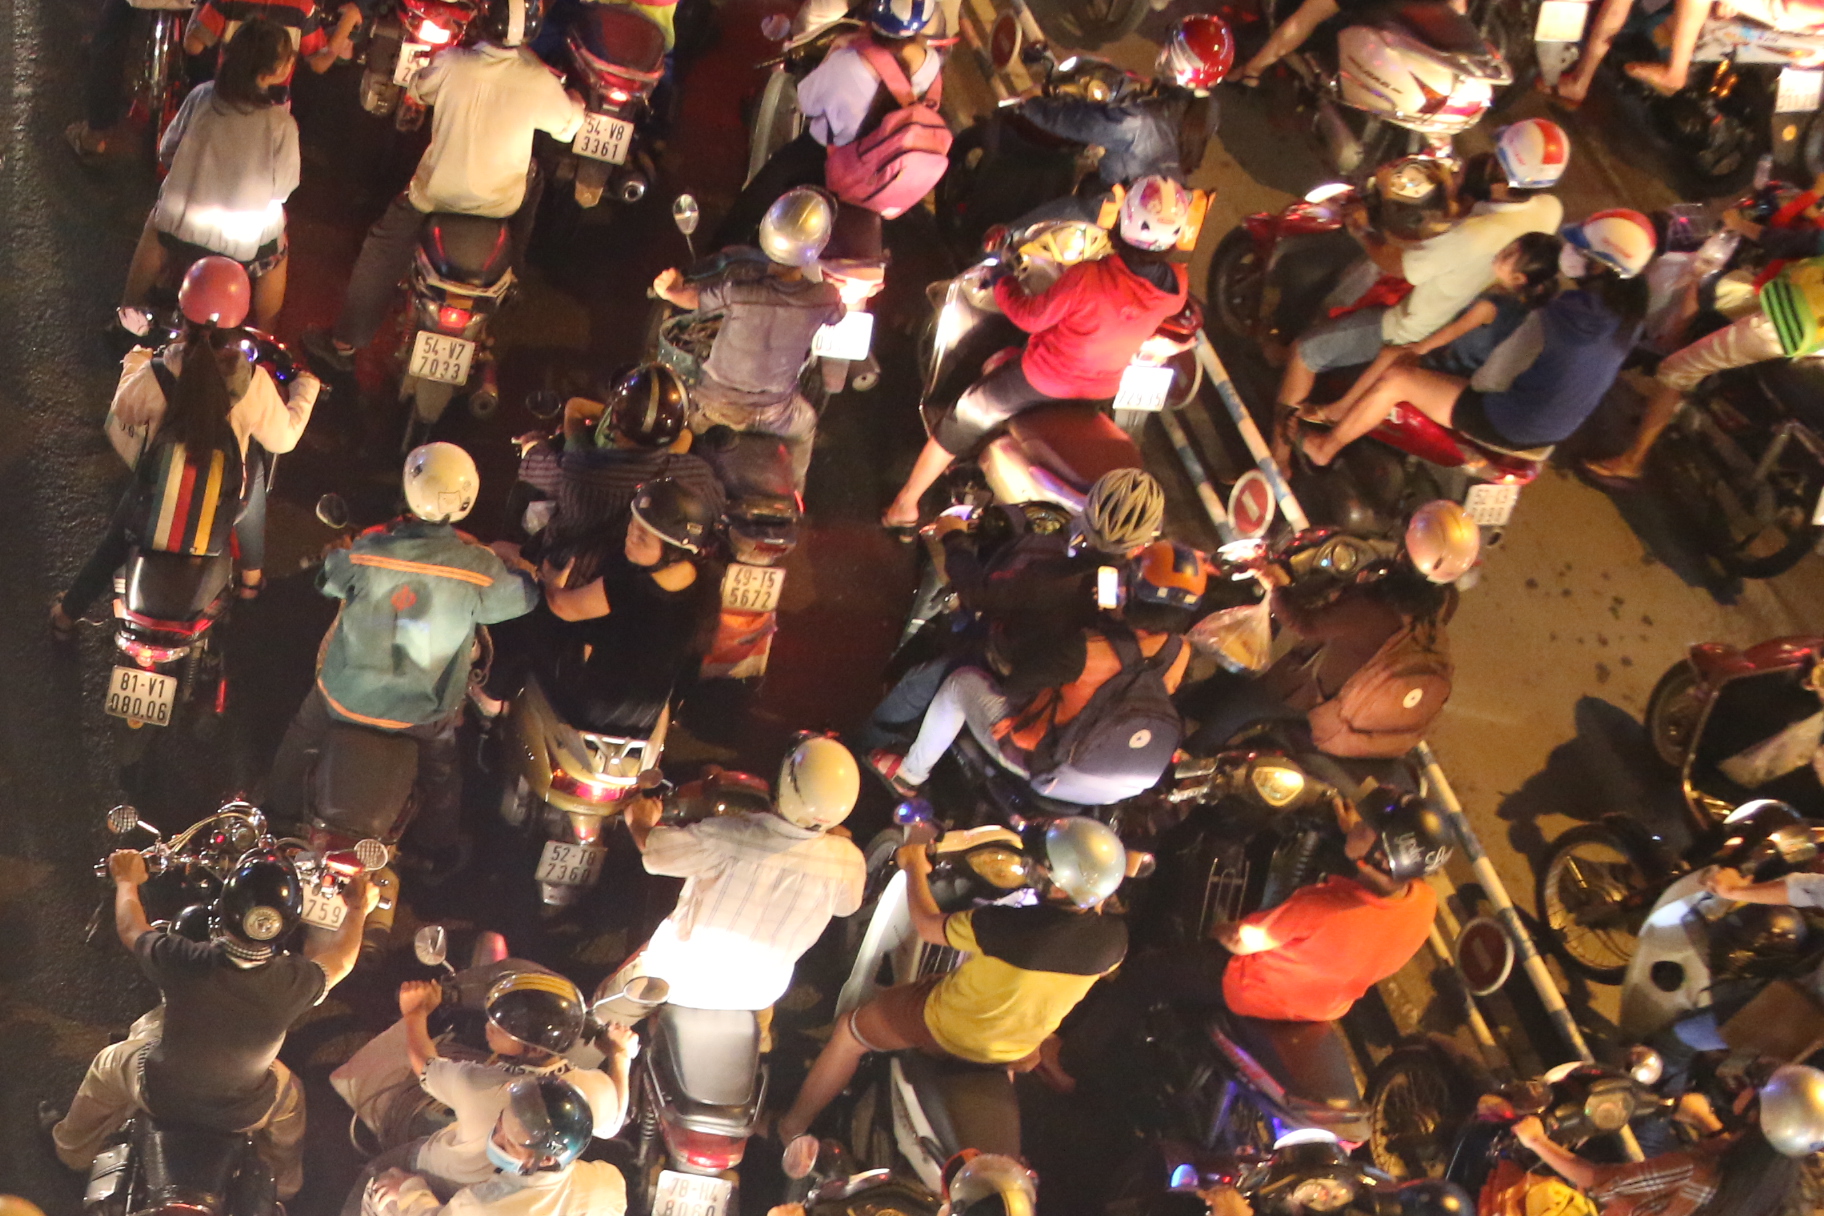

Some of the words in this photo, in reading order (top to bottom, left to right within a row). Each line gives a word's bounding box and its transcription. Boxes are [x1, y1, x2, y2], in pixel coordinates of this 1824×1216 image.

[586, 118, 625, 141] 54-V8
[581, 136, 618, 159] 3361
[423, 336, 465, 361] 54-V7
[418, 356, 461, 380] 7033
[734, 567, 777, 587] 49-T5
[729, 588, 769, 609] 5672
[120, 672, 165, 698] 81-V1
[111, 693, 168, 720] 080.06
[545, 864, 589, 882] 7360
